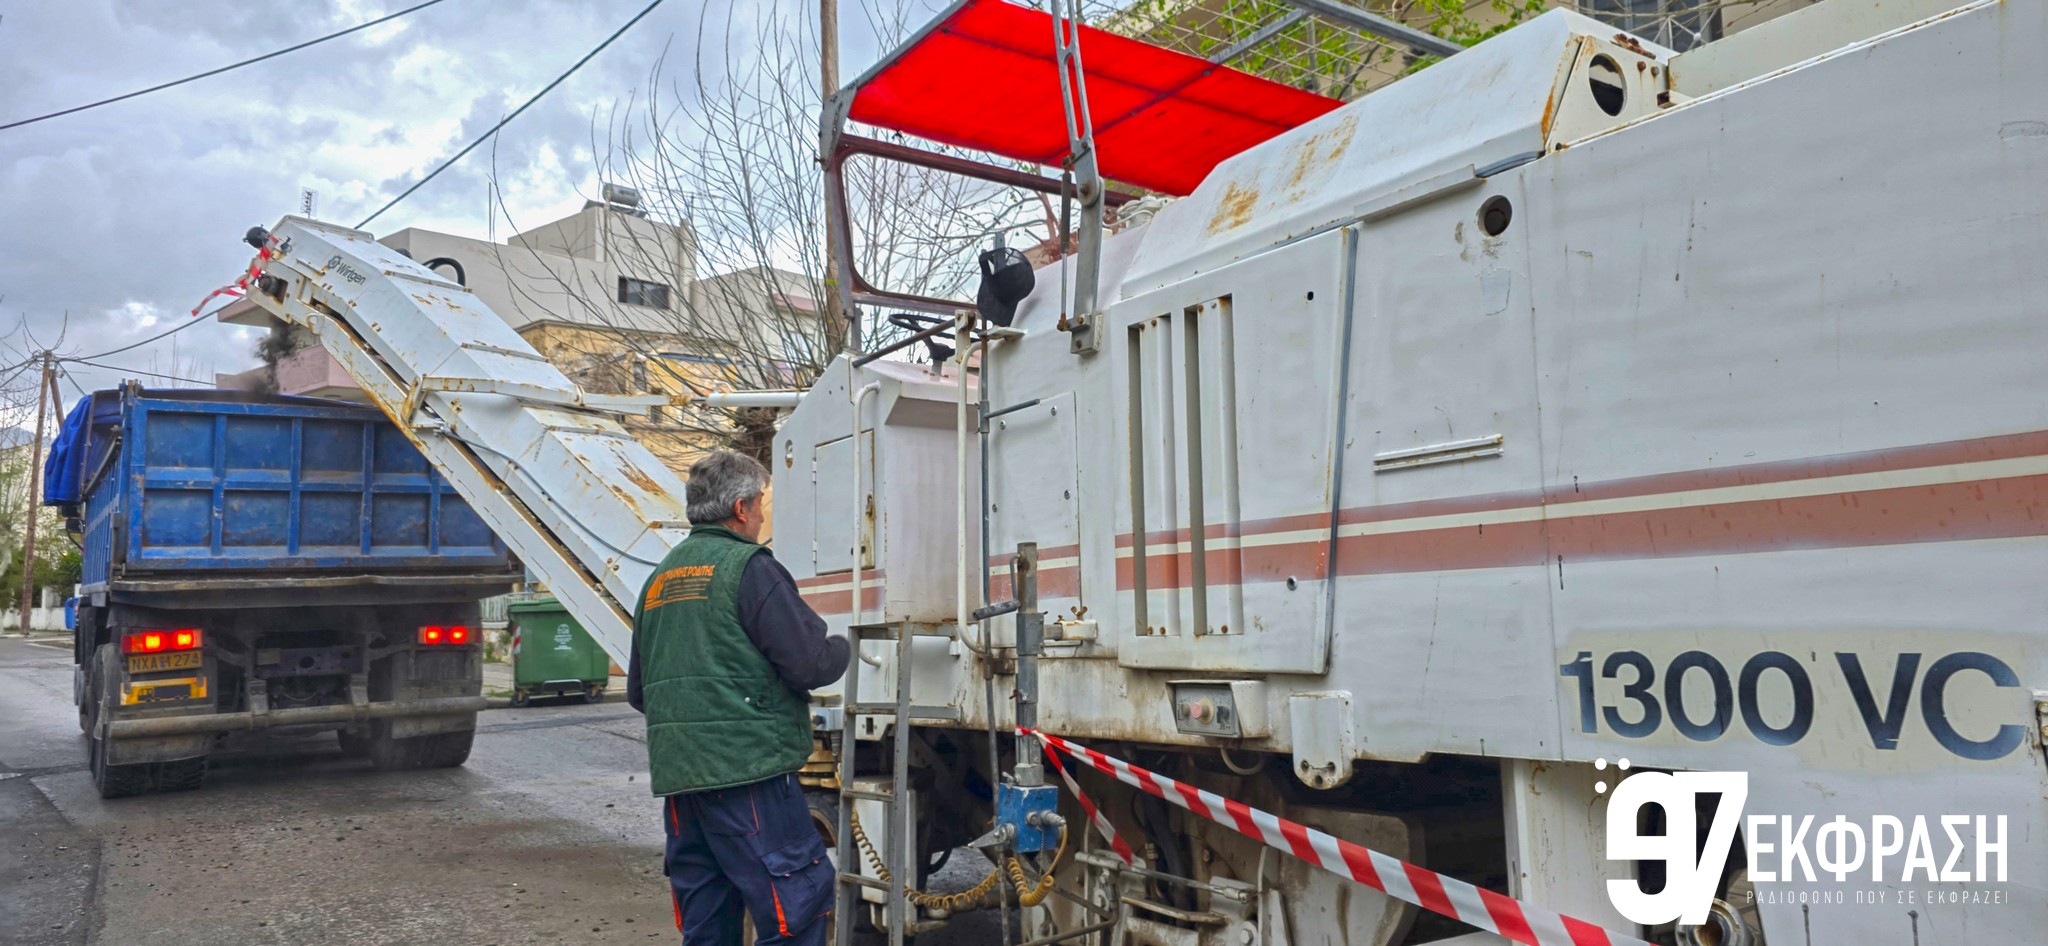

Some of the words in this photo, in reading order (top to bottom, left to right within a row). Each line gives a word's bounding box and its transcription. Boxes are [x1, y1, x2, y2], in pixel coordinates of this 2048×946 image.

[336, 262, 367, 286] Wirtgen
[1559, 649, 1815, 747] 1300
[1833, 650, 2027, 761] VC
